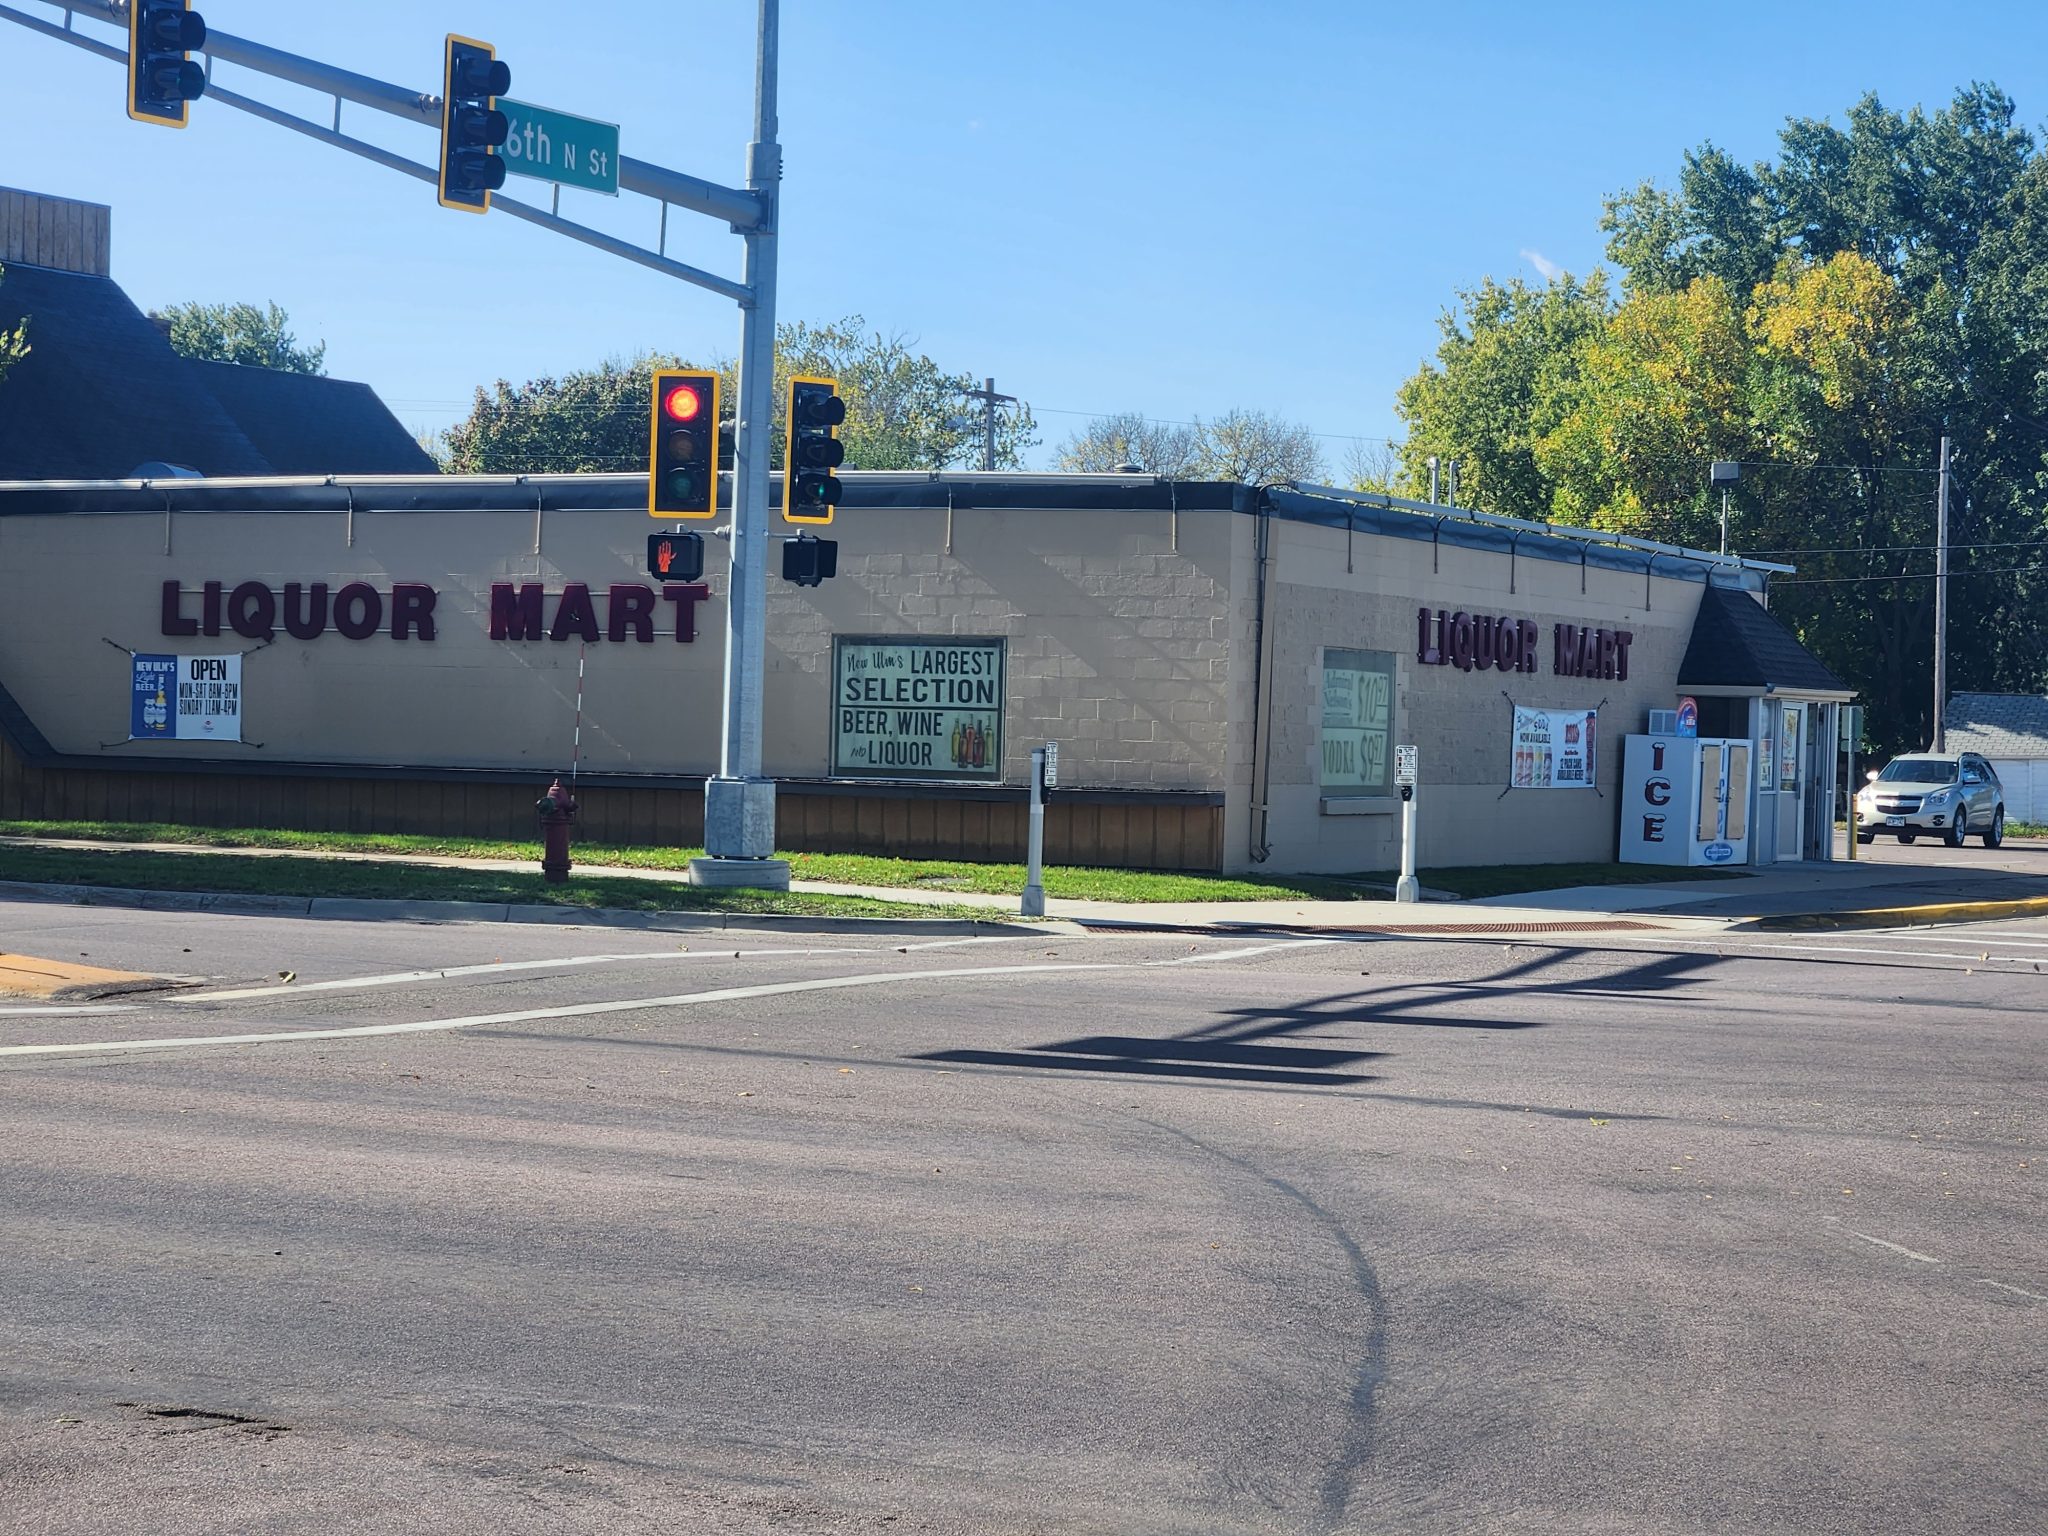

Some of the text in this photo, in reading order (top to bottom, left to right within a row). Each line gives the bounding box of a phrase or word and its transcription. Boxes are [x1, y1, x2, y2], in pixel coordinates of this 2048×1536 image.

[498, 118, 608, 177] 6th N St
[161, 580, 709, 643] LIQUOR MART
[1418, 607, 1633, 681] LIQUOR MART
[136, 661, 153, 672] NEW
[191, 659, 227, 681] OPEN
[847, 650, 994, 675] New Ulm's LARGEST
[179, 683, 207, 699] MON-SAT
[846, 677, 994, 704] SELECTION
[179, 699, 203, 716] SUNDAY
[843, 710, 944, 737] BEER, WINE
[868, 741, 932, 766] LIQUOR
[1322, 739, 1355, 774] VODKA
[1642, 742, 1672, 843] ICE
